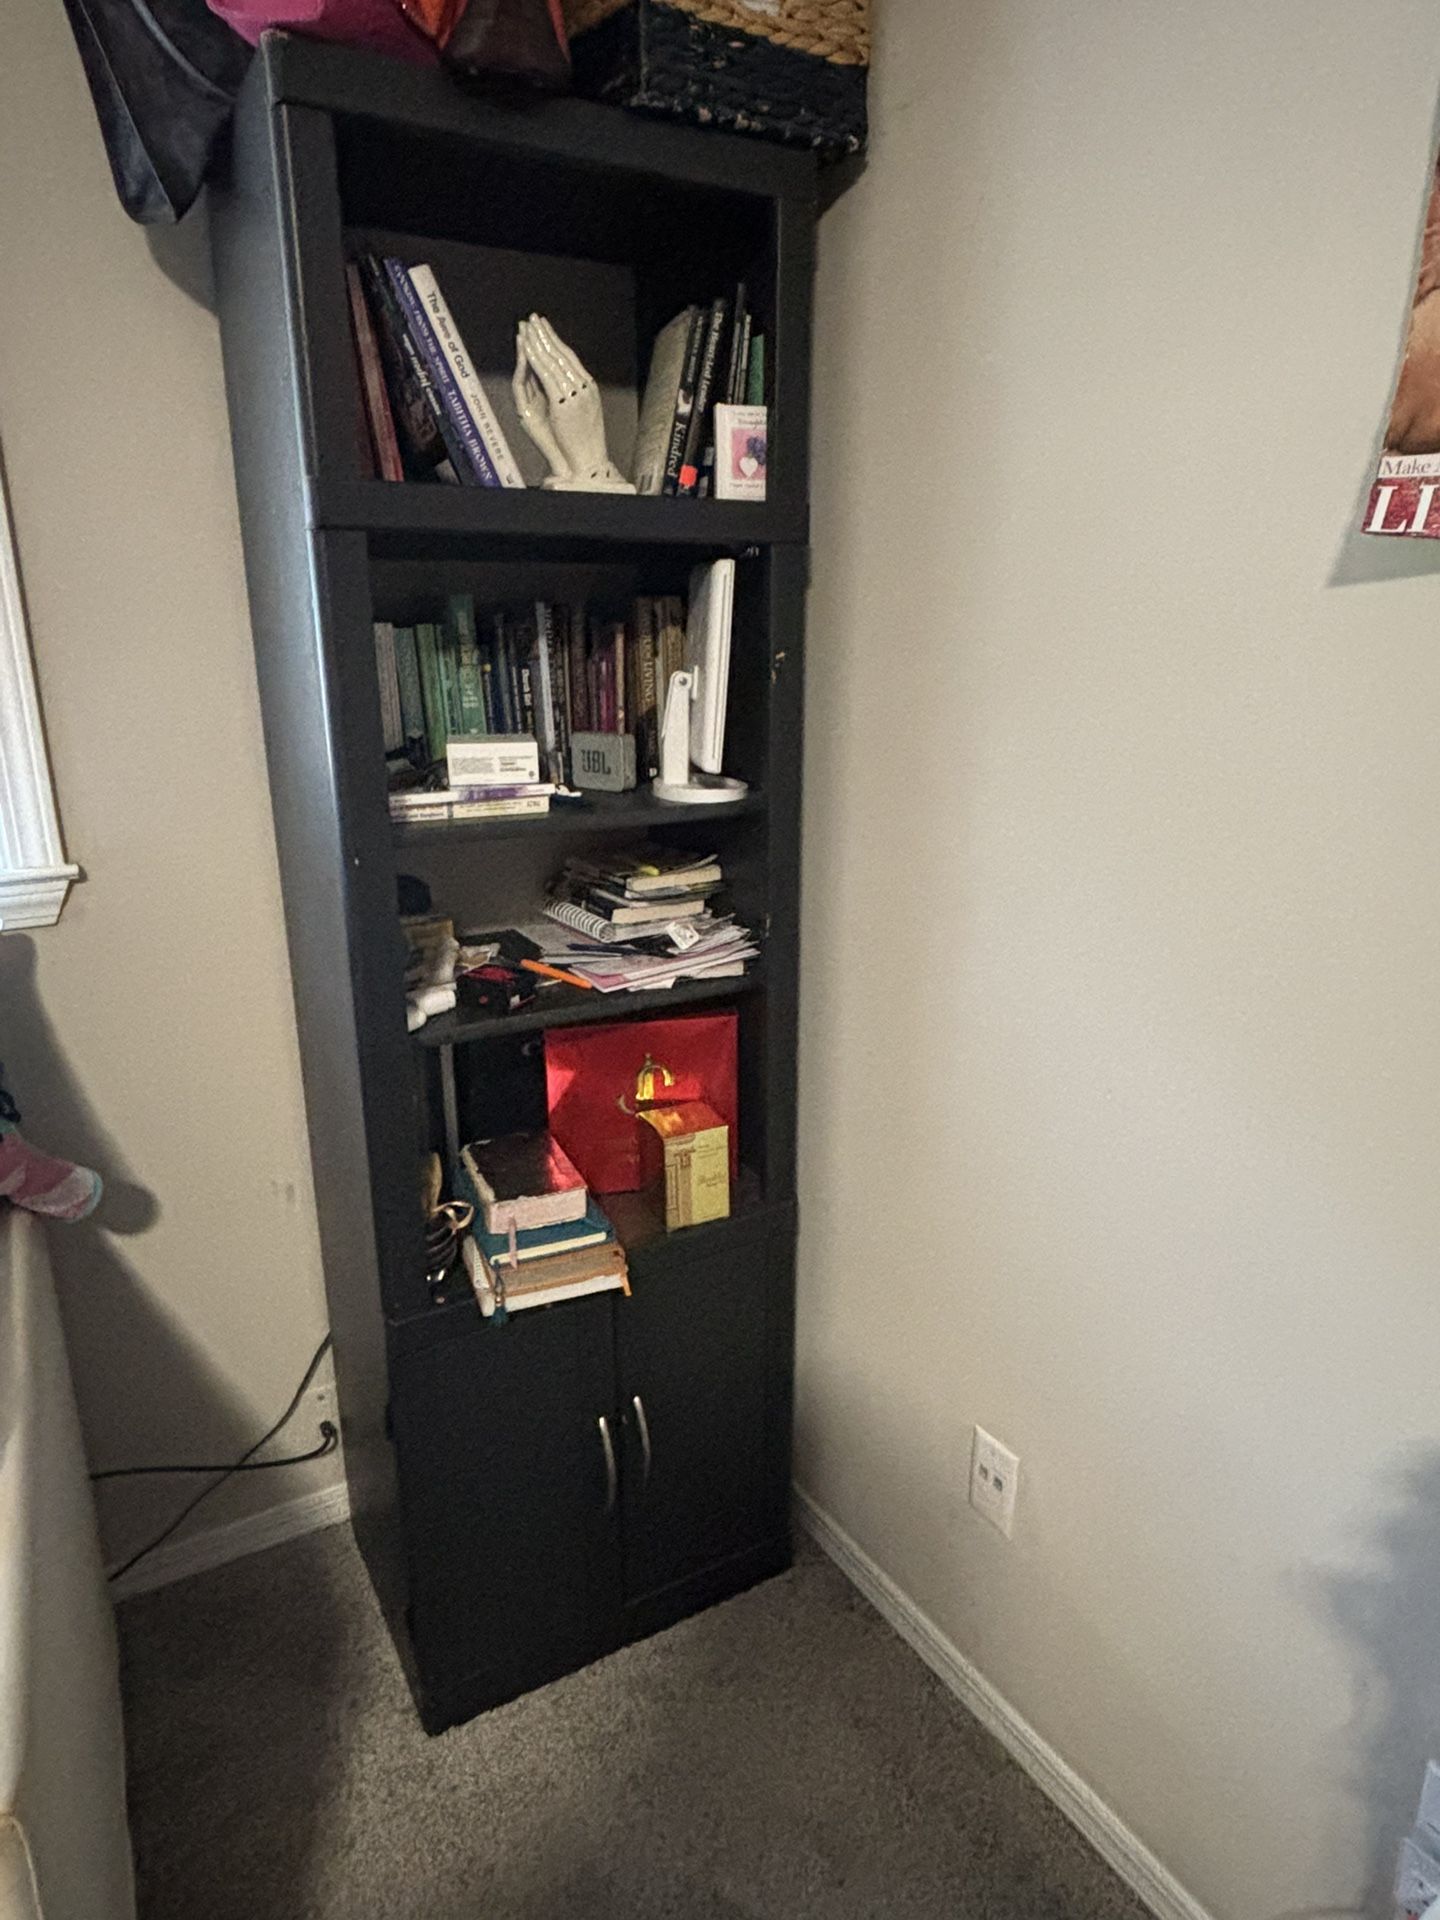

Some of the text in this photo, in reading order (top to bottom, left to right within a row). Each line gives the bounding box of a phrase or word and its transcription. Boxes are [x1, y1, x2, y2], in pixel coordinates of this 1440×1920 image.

[426, 292, 471, 379] The Awe of God
[470, 392, 487, 420] JOHN
[448, 389, 472, 436] TABITHA
[467, 434, 493, 480] BROWN
[666, 422, 687, 479] Kindred
[1382, 458, 1431, 475] Make
[643, 661, 656, 702] LIVING
[580, 749, 612, 775] JBL
